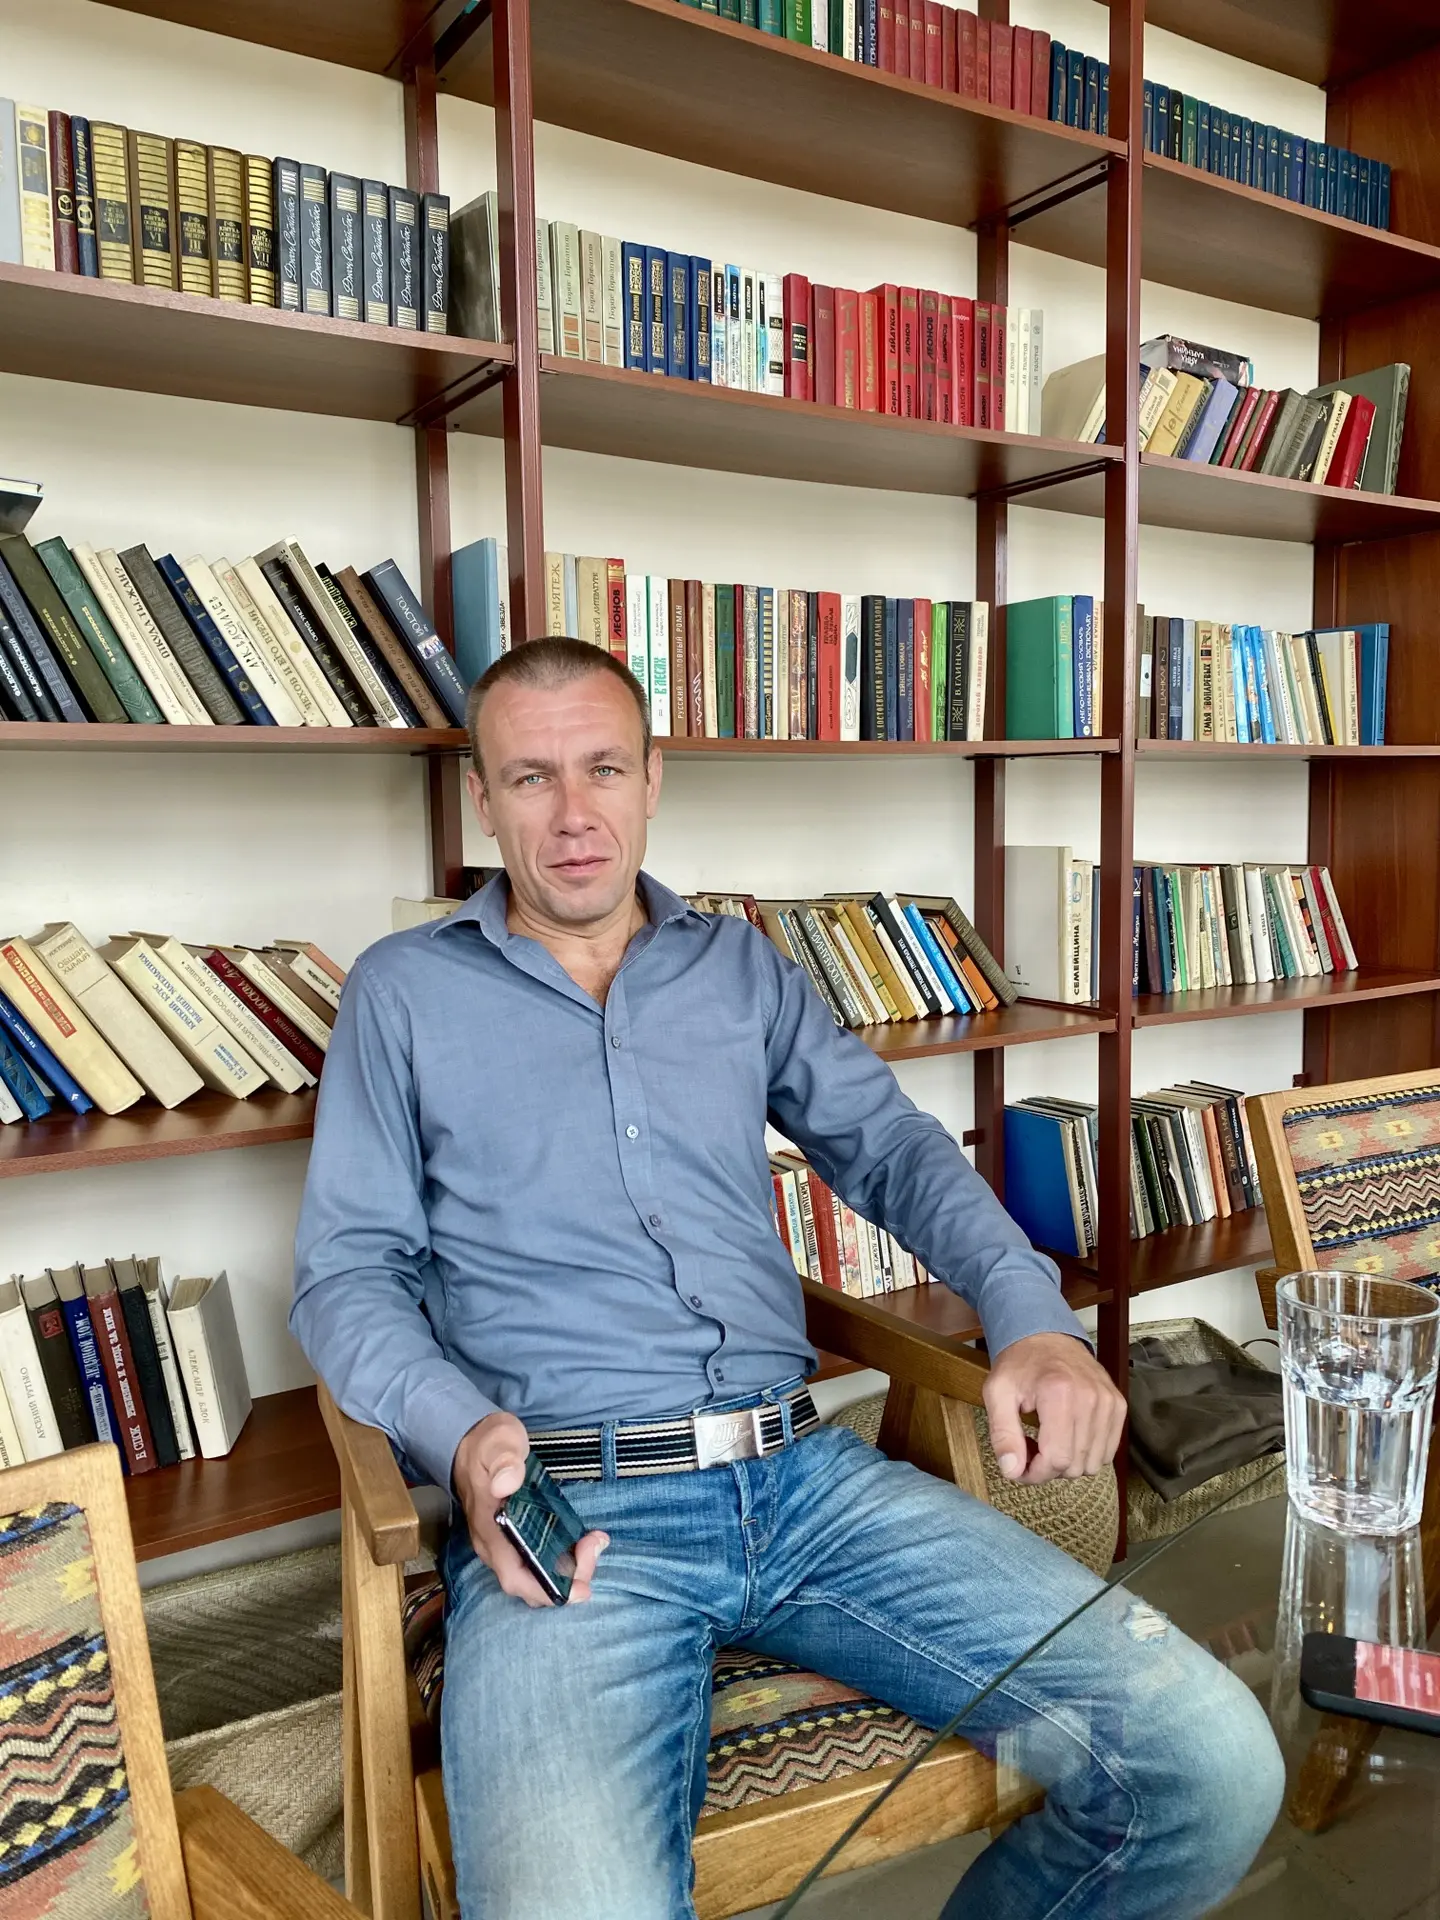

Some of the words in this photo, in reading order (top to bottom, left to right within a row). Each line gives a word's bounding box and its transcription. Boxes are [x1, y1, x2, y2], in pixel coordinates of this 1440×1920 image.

[76, 130, 87, 179] Гончаров
[150, 233, 161, 243] VI
[189, 240, 201, 249] III
[224, 243, 234, 252] IV
[253, 252, 270, 262] VII
[926, 317, 934, 360] ЛЕОНОВ
[890, 380, 898, 413] Сергей
[112, 564, 137, 600] ЖАН?
[549, 563, 561, 611] МЯТЕЖ
[247, 608, 273, 644] ВРЕМЯ
[393, 593, 427, 638] ТОЛСТОЙ
[612, 589, 621, 637] ЛЕОНОВ
[874, 599, 882, 646] КАРАМАЗОВЫ
[143, 618, 170, 659] ОТКУДА
[268, 644, 286, 666] ЕГО
[345, 639, 371, 675] ЭРТЕЛЬ
[874, 649, 883, 674] БРАТЬЯ
[282, 666, 292, 676] И
[653, 657, 666, 685] ЛЕСАХ
[898, 672, 906, 696] ГЕЙНЦ
[288, 676, 313, 710] ЧЕХОВ
[1201, 663, 1212, 709] ЗВОНАРЕВЫХ
[1203, 712, 1212, 736] СЕМЬЯ
[800, 910, 817, 931] ГОД
[4, 948, 42, 994] МОСКВУ
[55, 945, 86, 969] ОБЩАЯ
[809, 929, 843, 985] ПОСЛЕДНИЙ
[137, 951, 177, 995] МАТЕМАТИКИ
[151, 983, 170, 1001] КУРС
[167, 1001, 196, 1029] КРАТКИЙ
[175, 993, 204, 1023] ВЫСШЕЙ
[211, 994, 239, 1022] ВОПРОСОВ
[240, 1025, 259, 1045] ЗАДАЧ
[804, 1218, 818, 1256] Шукшин
[74, 1315, 92, 1339] ДОМ
[102, 1306, 116, 1331] НИМ
[107, 1329, 119, 1344] ЗА
[110, 1343, 125, 1368] УХОД
[19, 1365, 34, 1398] РУТЬКО
[187, 1348, 203, 1398] АЛЕКСАНДР
[198, 1400, 208, 1425] БЛОК
[28, 1399, 46, 1440] АРСЕНИЙ
[714, 1420, 743, 1442] NIKE
[129, 1423, 144, 1451] СПОК
